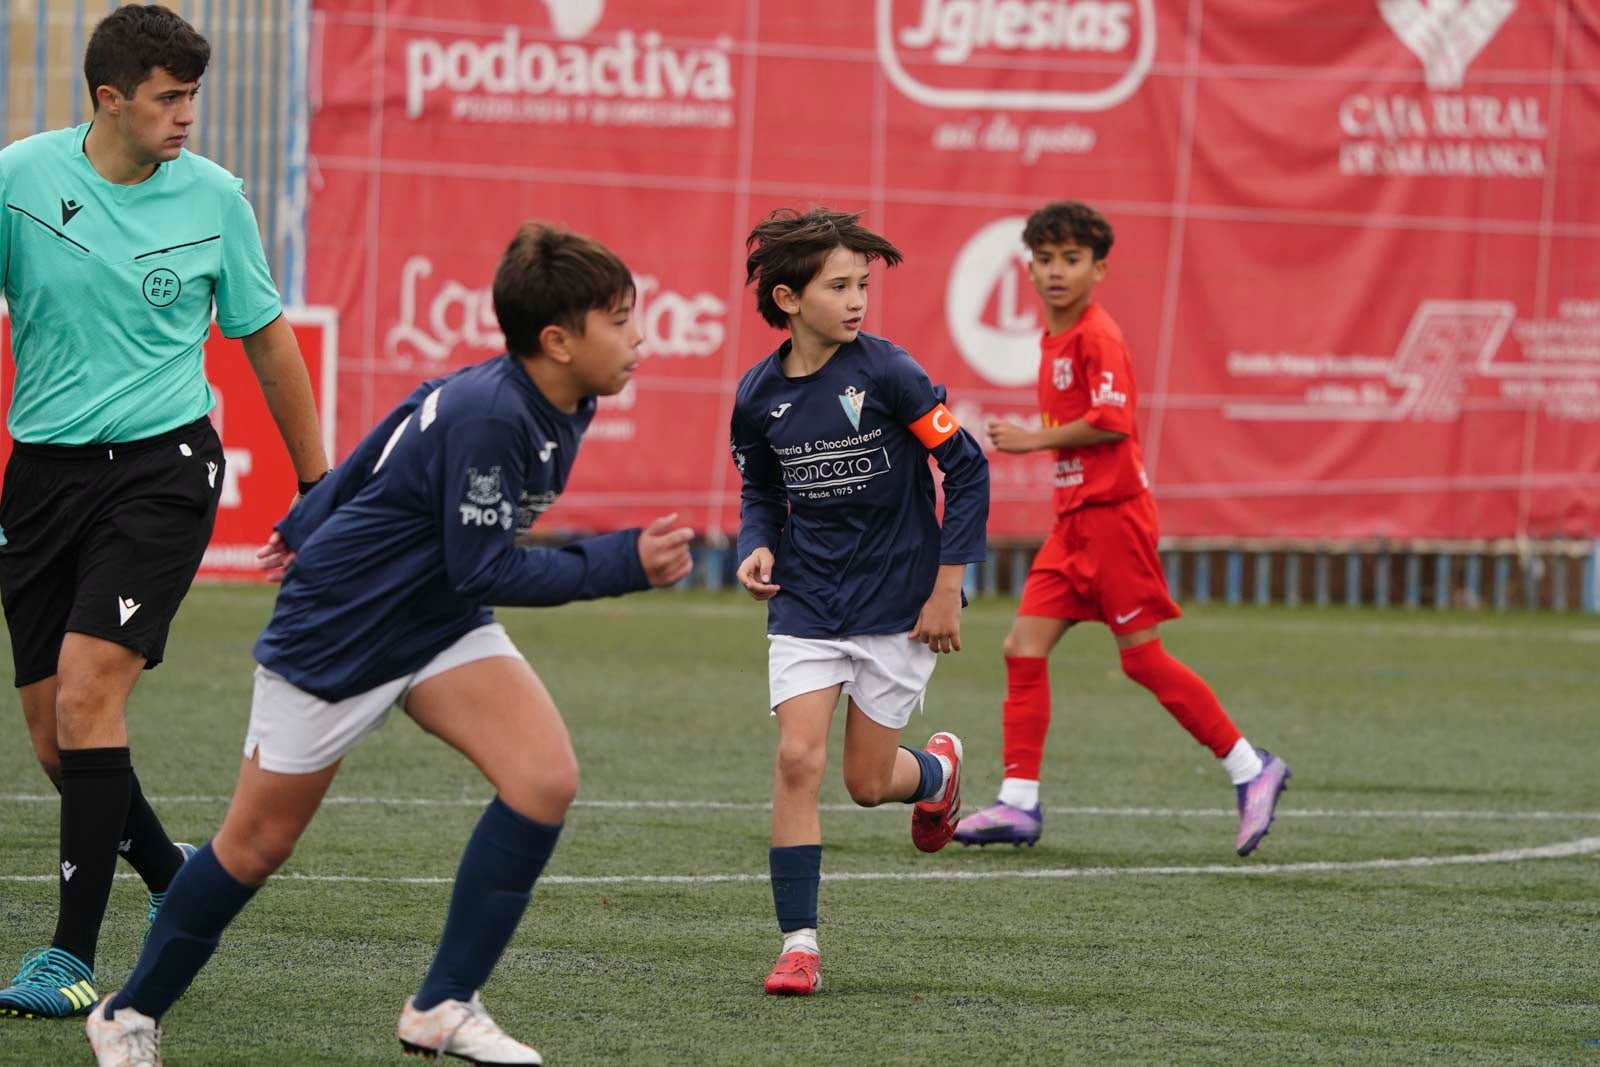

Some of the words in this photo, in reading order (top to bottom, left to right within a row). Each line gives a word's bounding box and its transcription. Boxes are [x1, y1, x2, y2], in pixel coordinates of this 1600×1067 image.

[405, 26, 733, 119] podoactiva
[932, 409, 953, 433] C
[807, 490, 831, 499] desde
[832, 486, 853, 497] 1975
